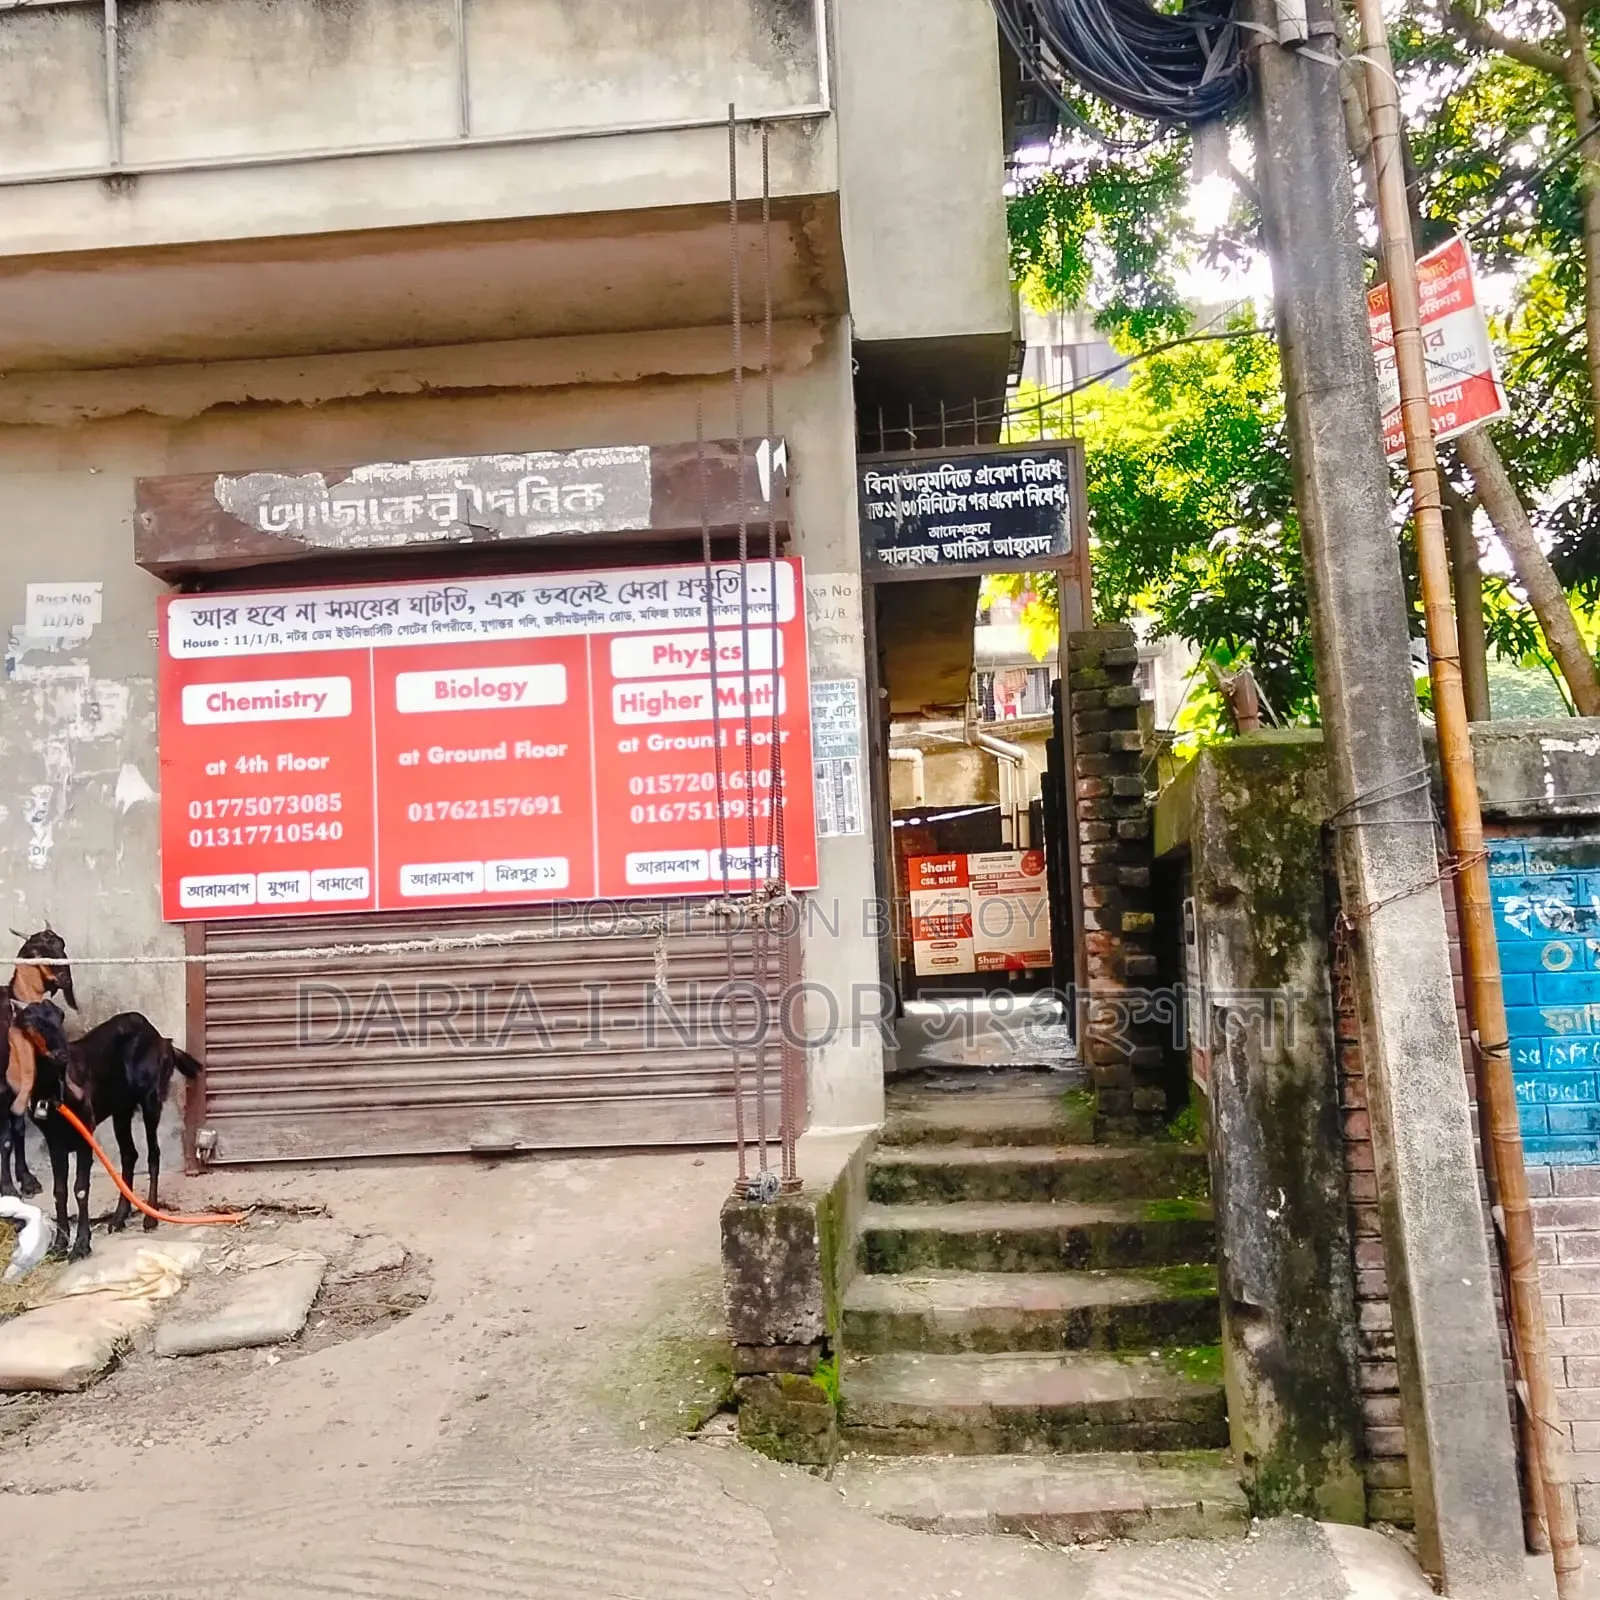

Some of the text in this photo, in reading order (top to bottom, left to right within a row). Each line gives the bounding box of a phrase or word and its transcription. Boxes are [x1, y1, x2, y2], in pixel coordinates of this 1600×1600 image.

[864, 471, 900, 495] বিনা
[974, 464, 1018, 486] প্রবেশ
[455, 474, 606, 518] দৈনিক
[989, 488, 1025, 510] প্রবেশ
[942, 535, 990, 560] আনিস
[72, 594, 92, 604] No
[191, 607, 240, 629] আর
[246, 604, 288, 626] হবে
[295, 602, 318, 624] না
[325, 595, 401, 622] সময়ের
[407, 586, 476, 617] ঘাটতি,
[485, 589, 527, 608] এক
[533, 579, 609, 608] ভবনেই
[617, 578, 669, 605] সেরা
[832, 585, 852, 597] No
[182, 639, 220, 650] House
[234, 632, 283, 648] 11/1/B,
[286, 628, 308, 643] নটর
[311, 629, 332, 641] ডেম
[397, 621, 428, 637] গেটের
[480, 617, 514, 634] যুগান্তর
[518, 612, 541, 629] গলি,
[206, 688, 328, 713] Chemistry
[434, 677, 529, 702] Biology
[620, 689, 704, 716] Higher
[617, 727, 790, 753] at Ground Foor
[205, 752, 331, 776] at 4th Floor
[398, 740, 568, 766] at Ground Floor
[188, 792, 343, 819] 01775073085
[407, 795, 563, 823] 01762157691
[189, 821, 343, 848] 01317710540
[410, 865, 557, 887] আরামবাগ মিরপুর ১১
[636, 859, 700, 875] আরামবাগ
[920, 860, 957, 874] Sharif
[938, 875, 958, 884] BUET
[186, 876, 365, 900] আরামবাগ মুগদা বাসাবো
[977, 955, 1006, 965] Sharif
